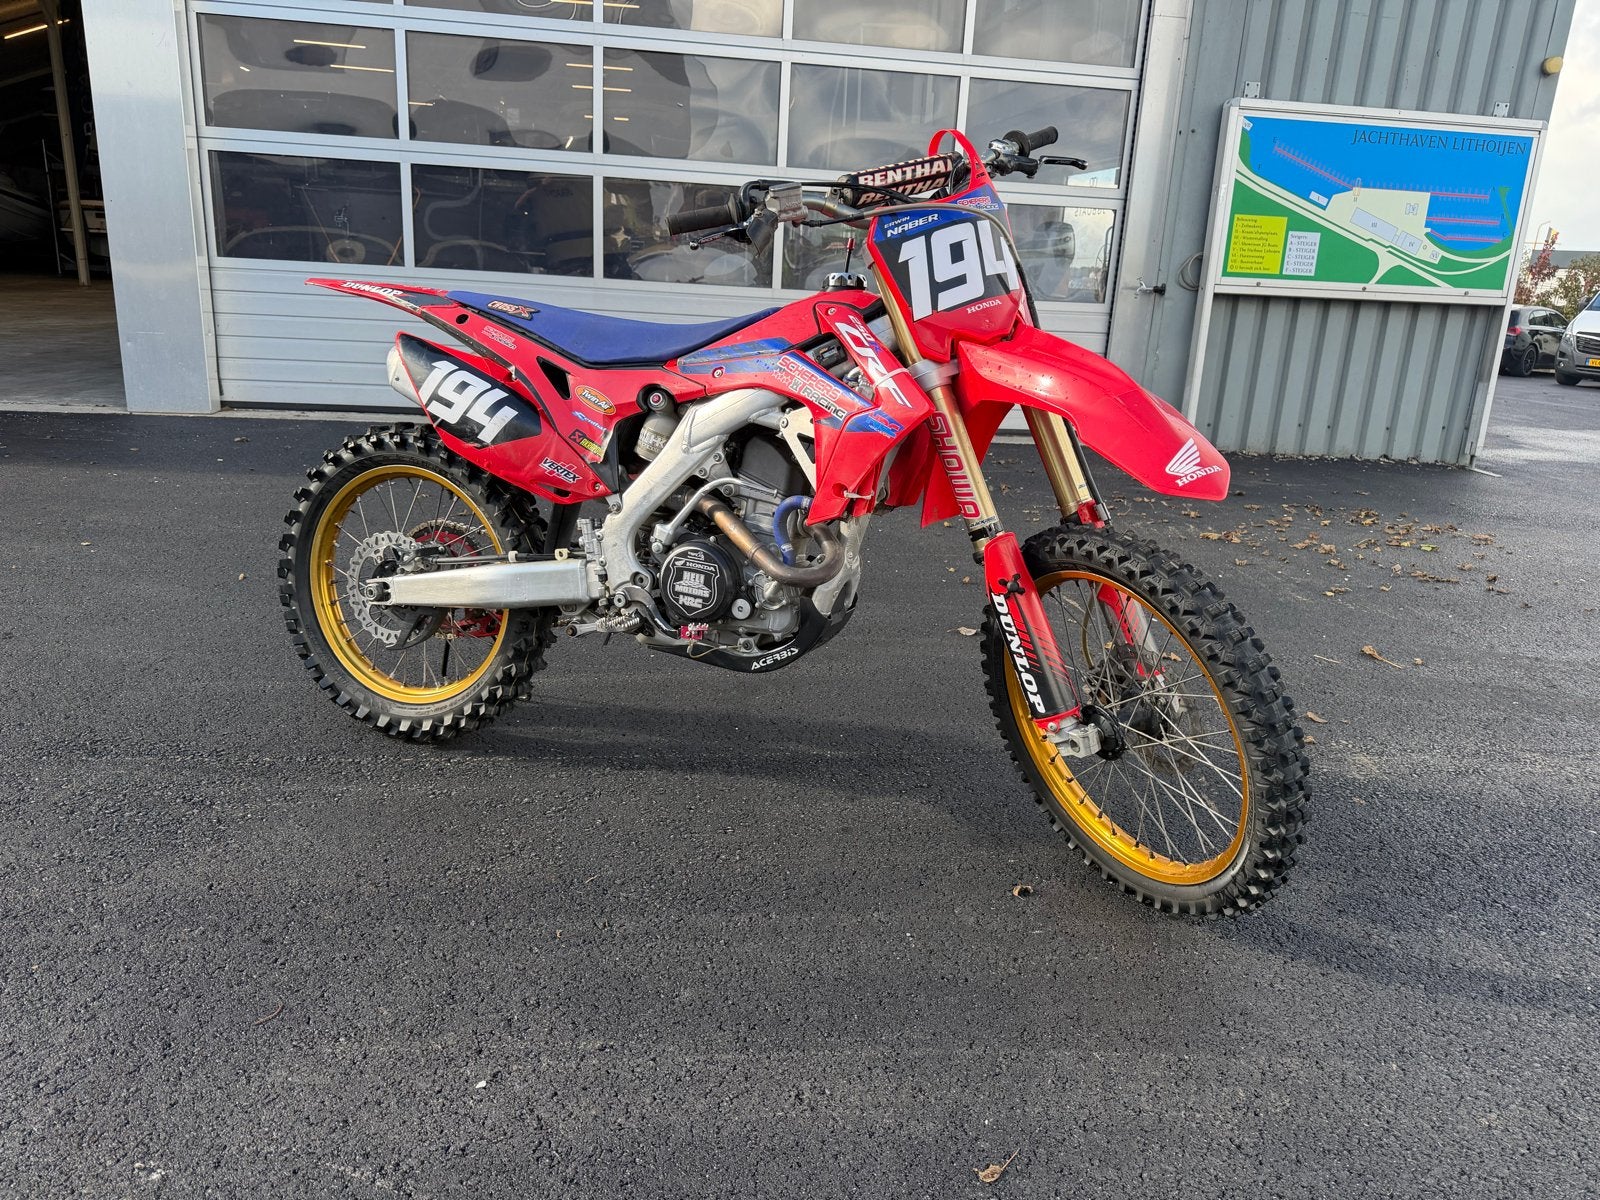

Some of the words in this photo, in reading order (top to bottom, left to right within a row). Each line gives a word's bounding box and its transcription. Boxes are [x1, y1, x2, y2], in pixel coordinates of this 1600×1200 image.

[1351, 129, 1449, 150] JACHTHAVEN
[1452, 138, 1527, 156] LITHOIJEN
[884, 215, 910, 229] ERWIN
[887, 213, 939, 237] NABER
[898, 219, 1020, 322] 194
[341, 281, 404, 297] DUNLOP
[966, 299, 1002, 314] HONDA
[777, 355, 842, 402] SCHEPERS
[418, 360, 519, 444] 194
[801, 386, 847, 421] RACING
[542, 457, 580, 482] VERTEX
[1174, 465, 1223, 488] HONDA
[685, 561, 716, 572] HONDA
[990, 592, 1046, 715] DUNLOP
